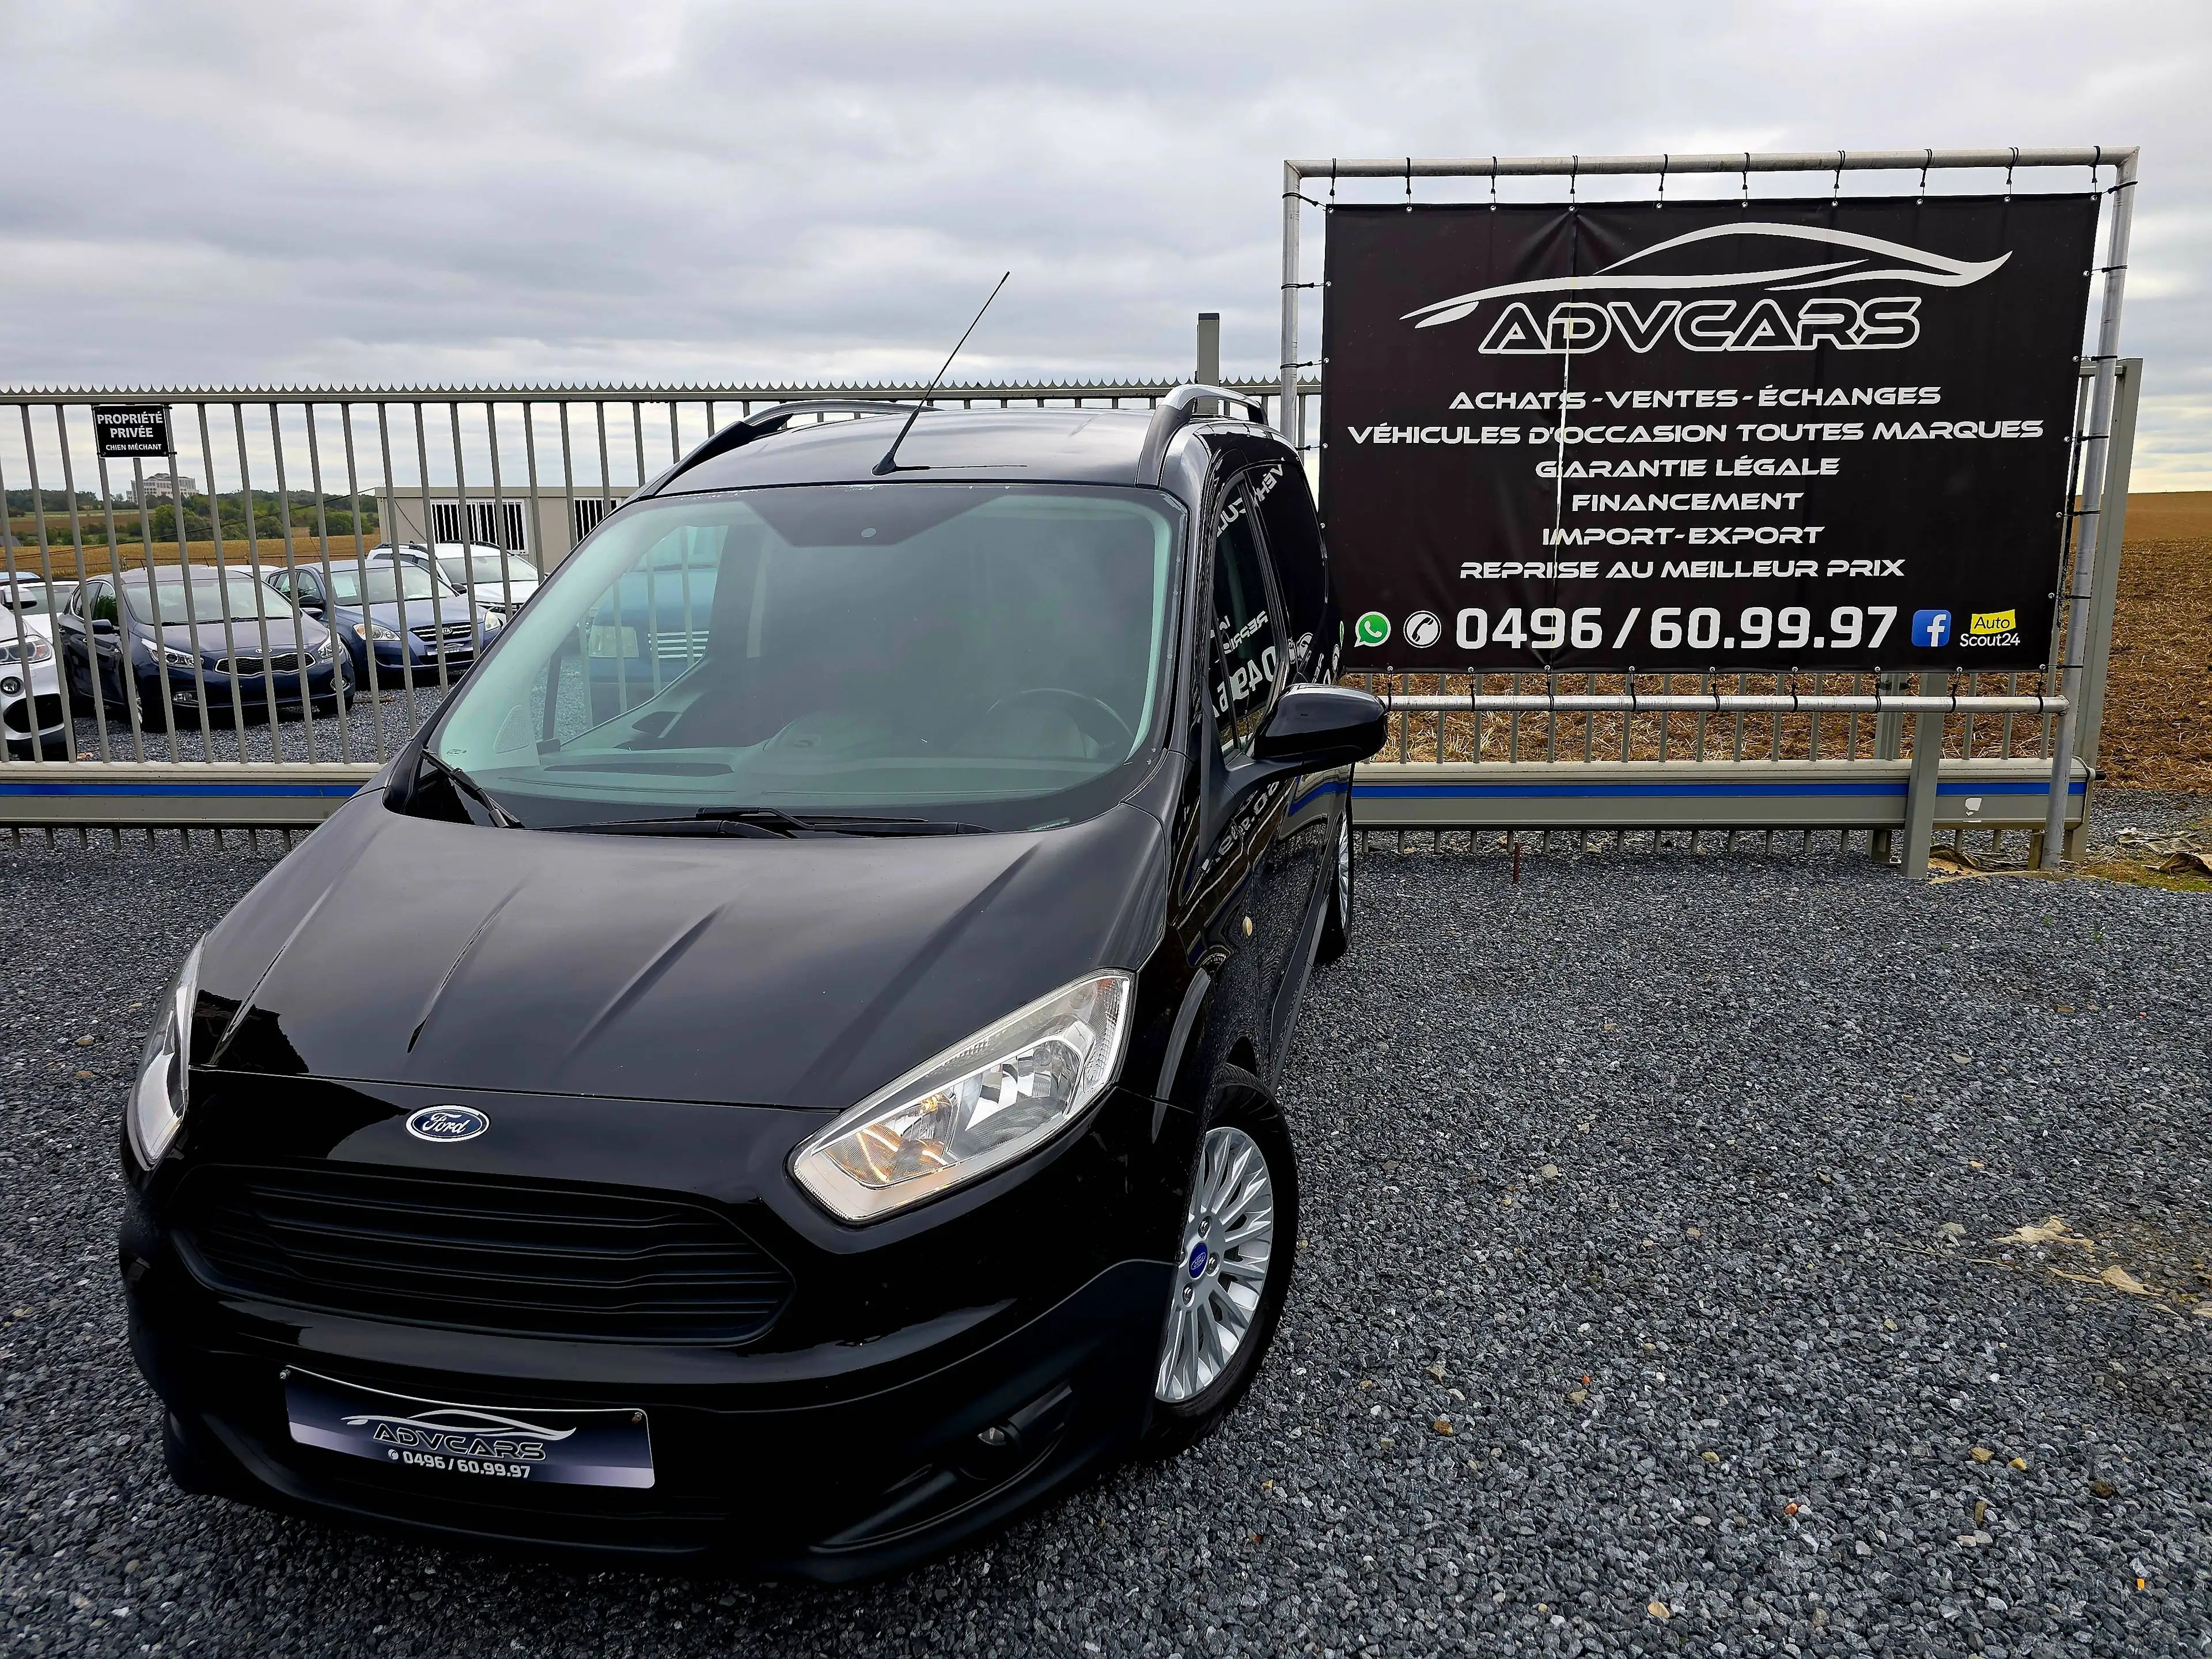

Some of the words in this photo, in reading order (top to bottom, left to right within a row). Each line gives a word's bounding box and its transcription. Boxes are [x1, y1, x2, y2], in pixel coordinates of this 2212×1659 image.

[1478, 297, 1922, 354] ADVCARS
[97, 411, 163, 425] PROPRIÉTÉ
[110, 425, 154, 438] PRIVÉE
[1347, 422, 1521, 444] VÉHICULES
[1528, 425, 1727, 444] D'OCCASION
[1736, 423, 1864, 442] TOUTES
[1873, 420, 2044, 440] MARQUES
[1536, 460, 1708, 478] GARANTIE
[1715, 454, 1841, 477] LÉGALE
[1571, 493, 1805, 512] FINANCEMENT
[1460, 561, 1600, 579] REPRISE
[1605, 560, 1654, 578] AU
[1661, 560, 1819, 578] MEILLEUR
[1827, 559, 1906, 577] PRIX
[1457, 607, 1603, 649] 0496
[1651, 606, 1897, 649] 60.99.97
[1974, 616, 2010, 629] Auto
[1959, 632, 2021, 647] Scout24
[422, 1112, 471, 1134] Ford
[373, 1423, 546, 1461] ADVCARS
[403, 1450, 446, 1469] 0496
[457, 1459, 531, 1479] 60.99.97
